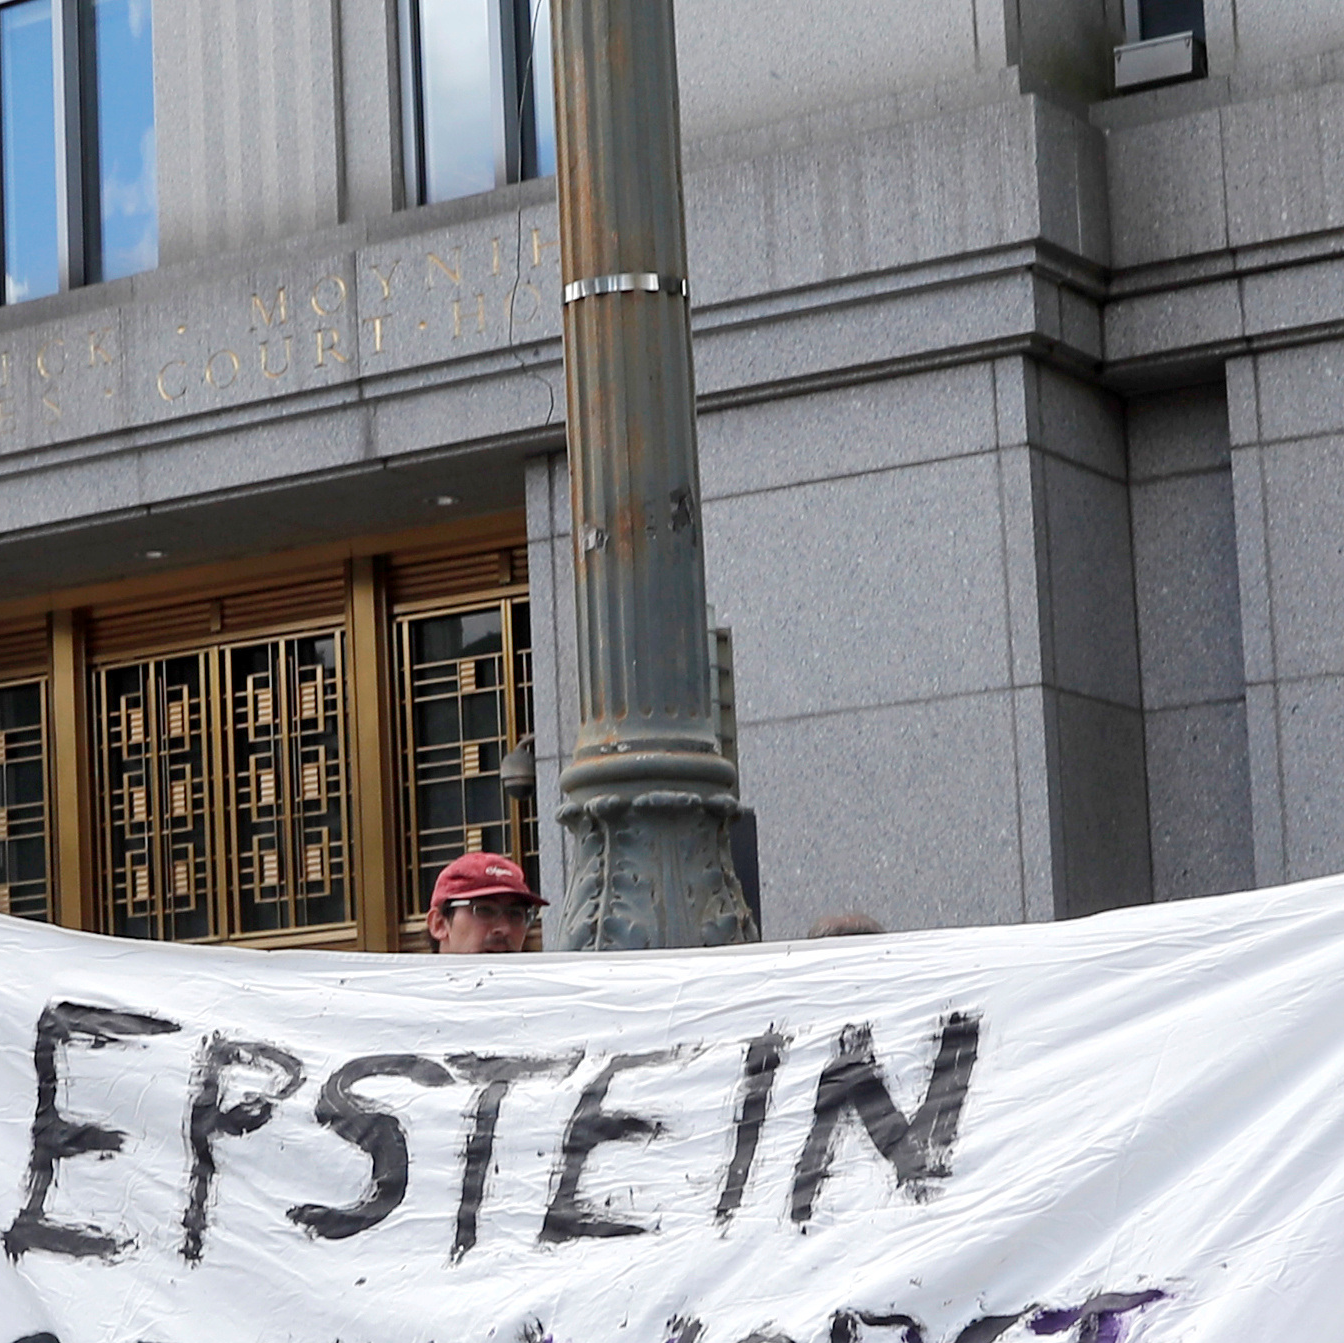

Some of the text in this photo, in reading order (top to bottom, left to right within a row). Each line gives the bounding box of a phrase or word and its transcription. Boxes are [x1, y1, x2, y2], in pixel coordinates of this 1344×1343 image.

[249, 228, 560, 333] MOYNIH
[158, 313, 395, 402] COURT
[1, 1000, 983, 1268] EPSTEIN
